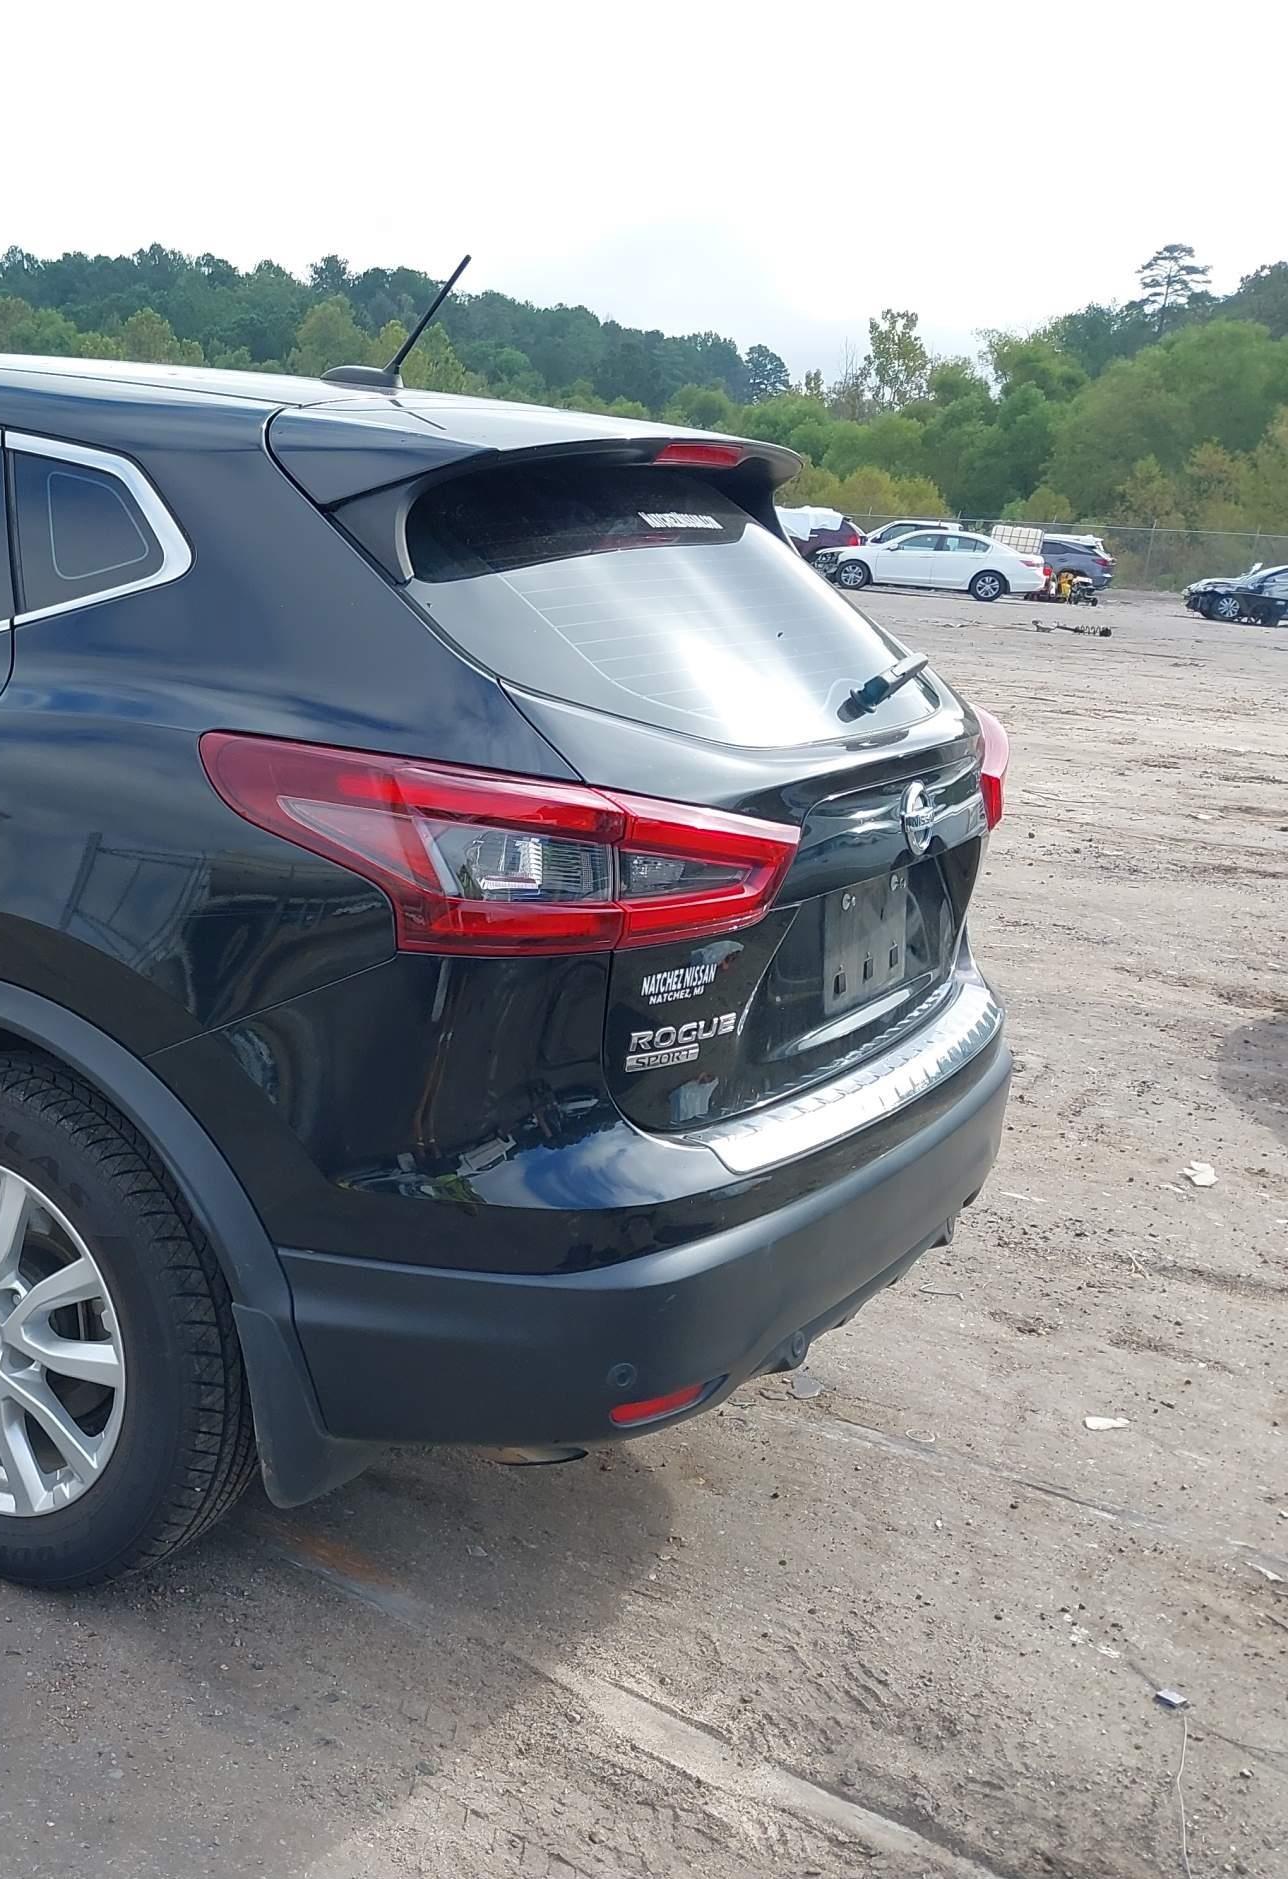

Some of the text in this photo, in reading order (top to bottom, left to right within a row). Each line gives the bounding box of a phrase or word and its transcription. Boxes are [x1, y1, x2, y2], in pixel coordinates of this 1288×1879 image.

[641, 964, 718, 996] NATCHEZ NISSAN
[630, 1012, 736, 1051] ROGUE
